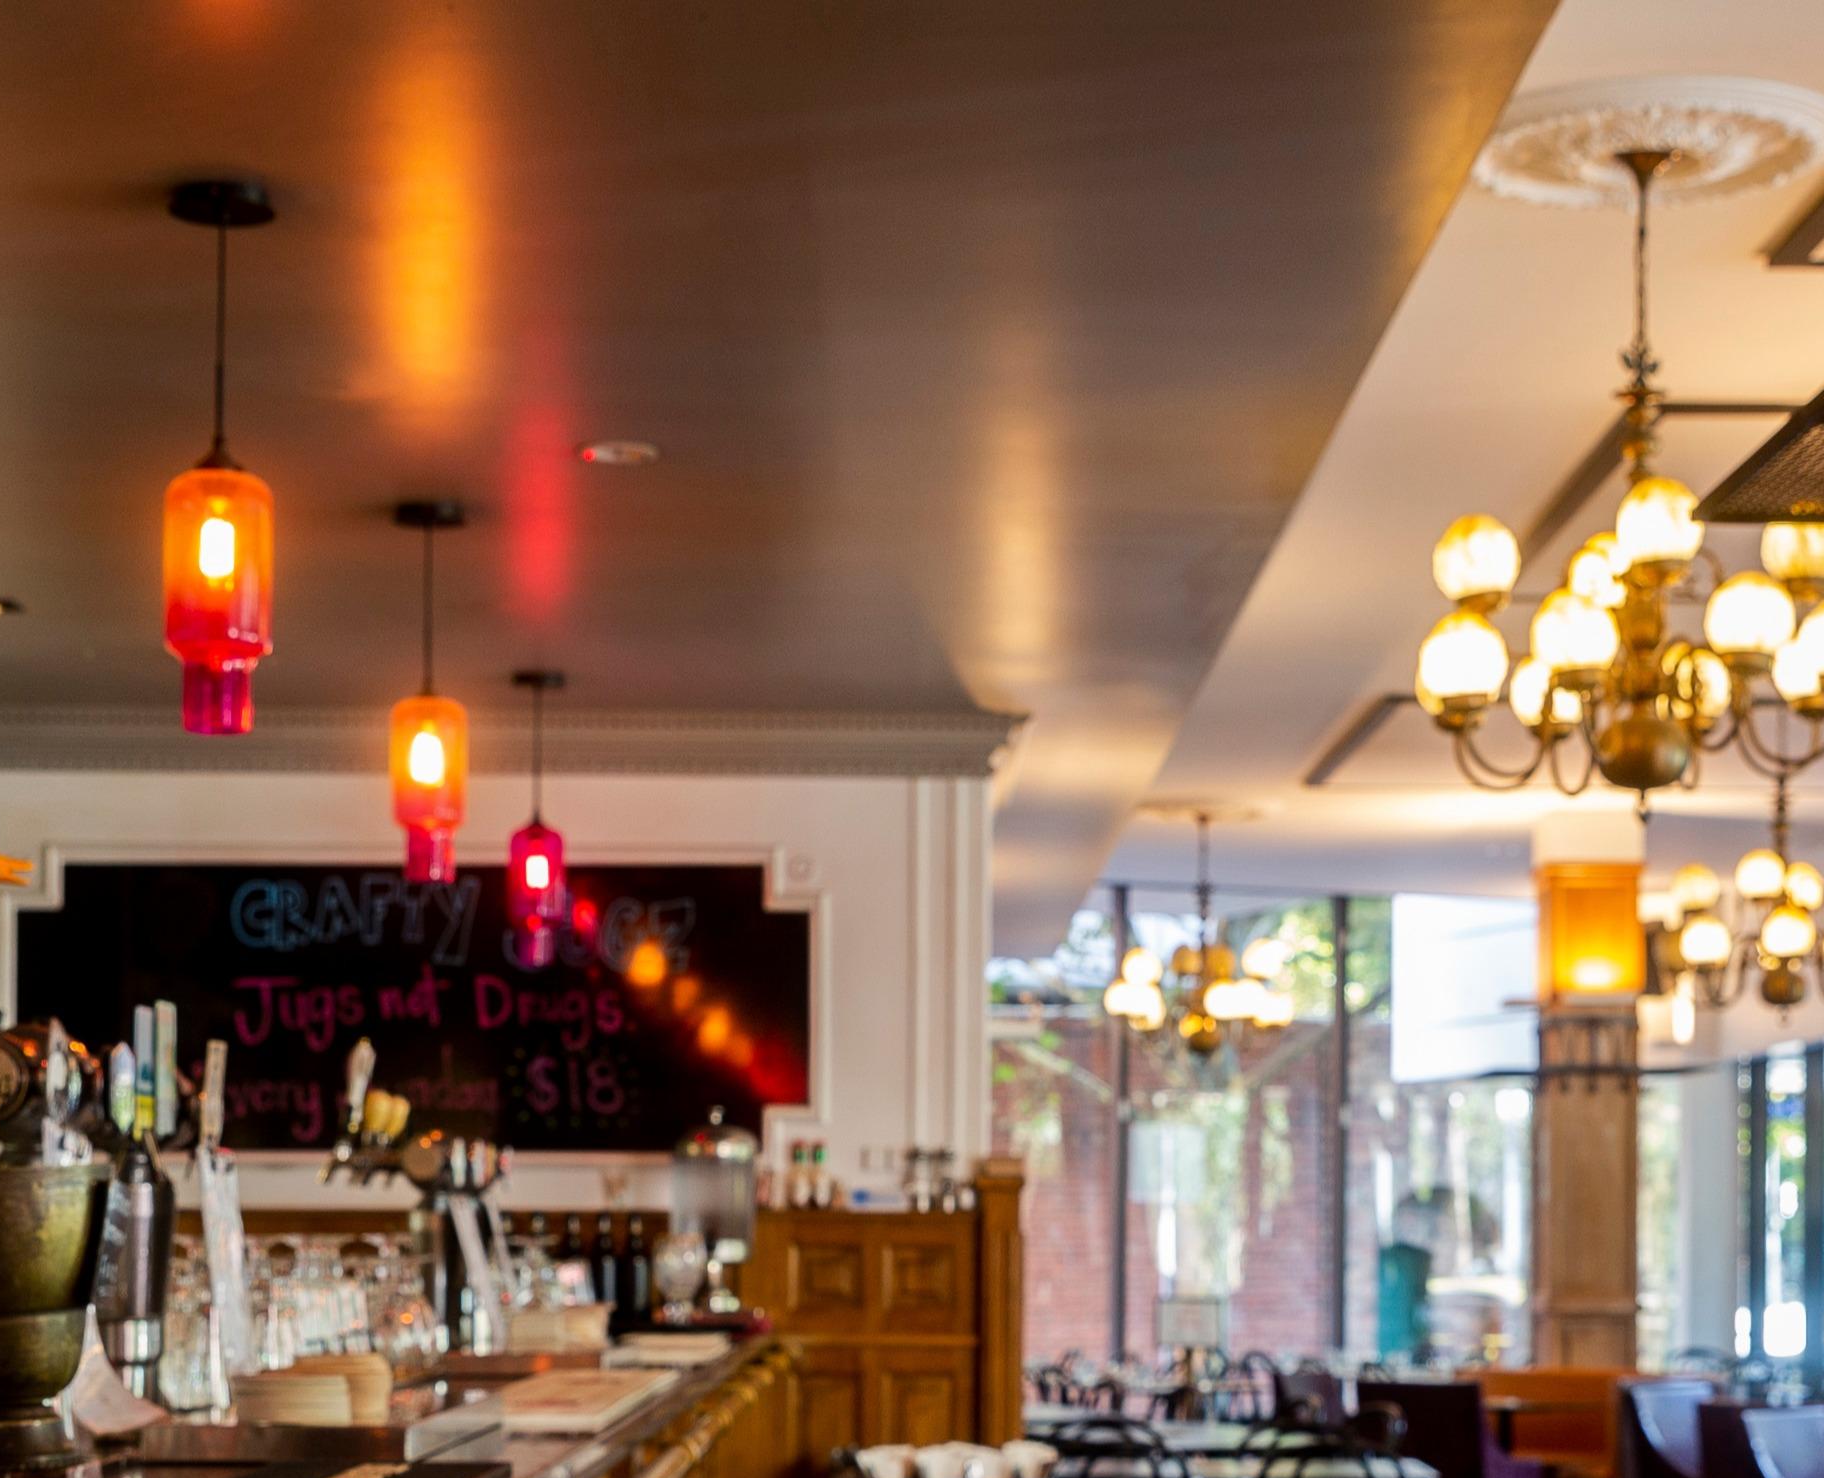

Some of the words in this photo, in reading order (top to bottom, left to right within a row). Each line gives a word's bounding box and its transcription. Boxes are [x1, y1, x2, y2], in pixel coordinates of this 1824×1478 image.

[233, 975, 366, 1053] Jugs
[379, 961, 452, 1029] not
[525, 1055, 626, 1117] $18
